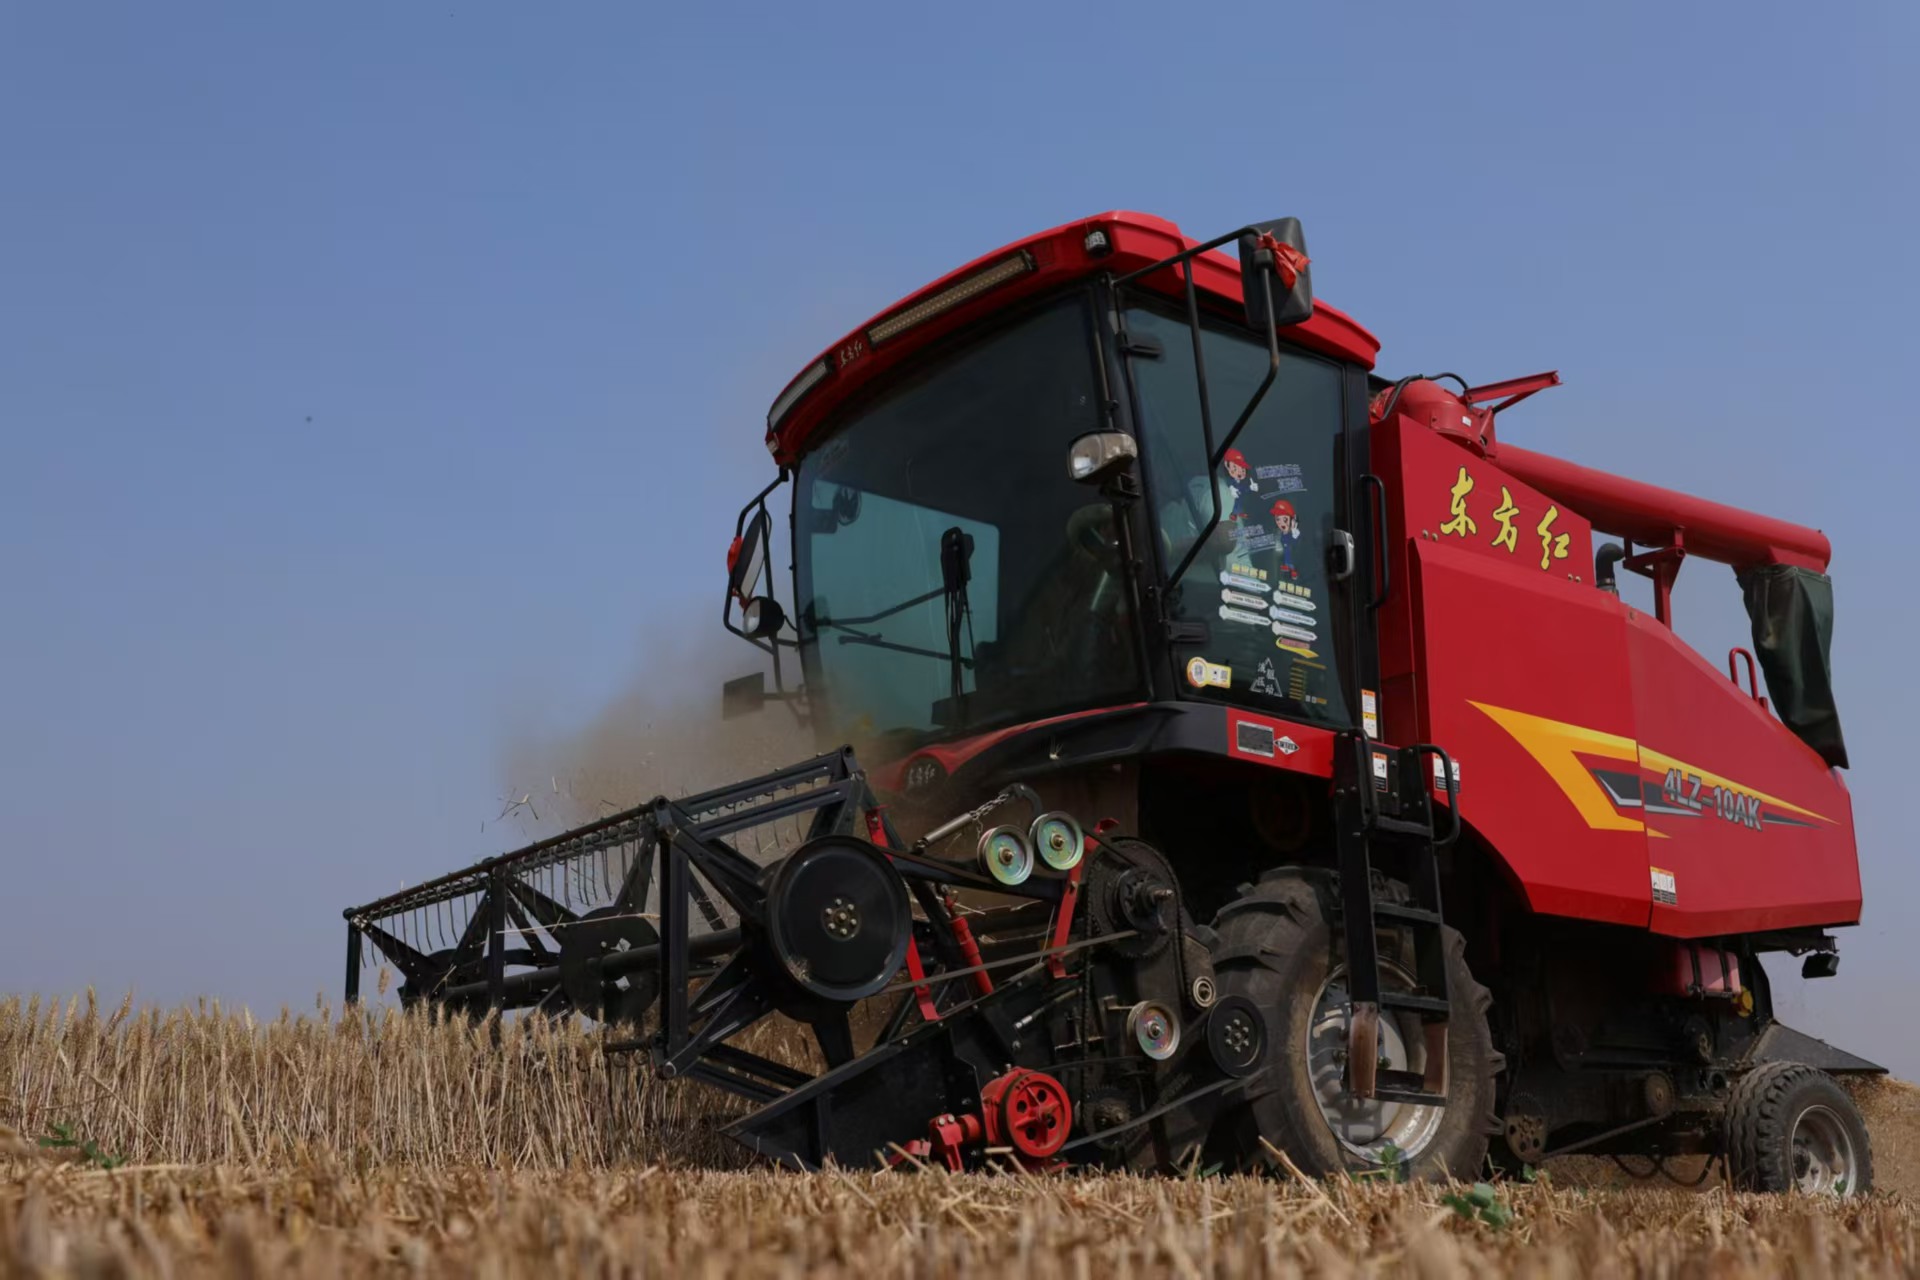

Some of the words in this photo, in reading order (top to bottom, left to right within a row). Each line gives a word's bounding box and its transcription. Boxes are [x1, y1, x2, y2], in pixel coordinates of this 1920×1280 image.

[1440, 466, 1570, 570] 东方红
[1664, 768, 1763, 832] 4LZ-10AK
